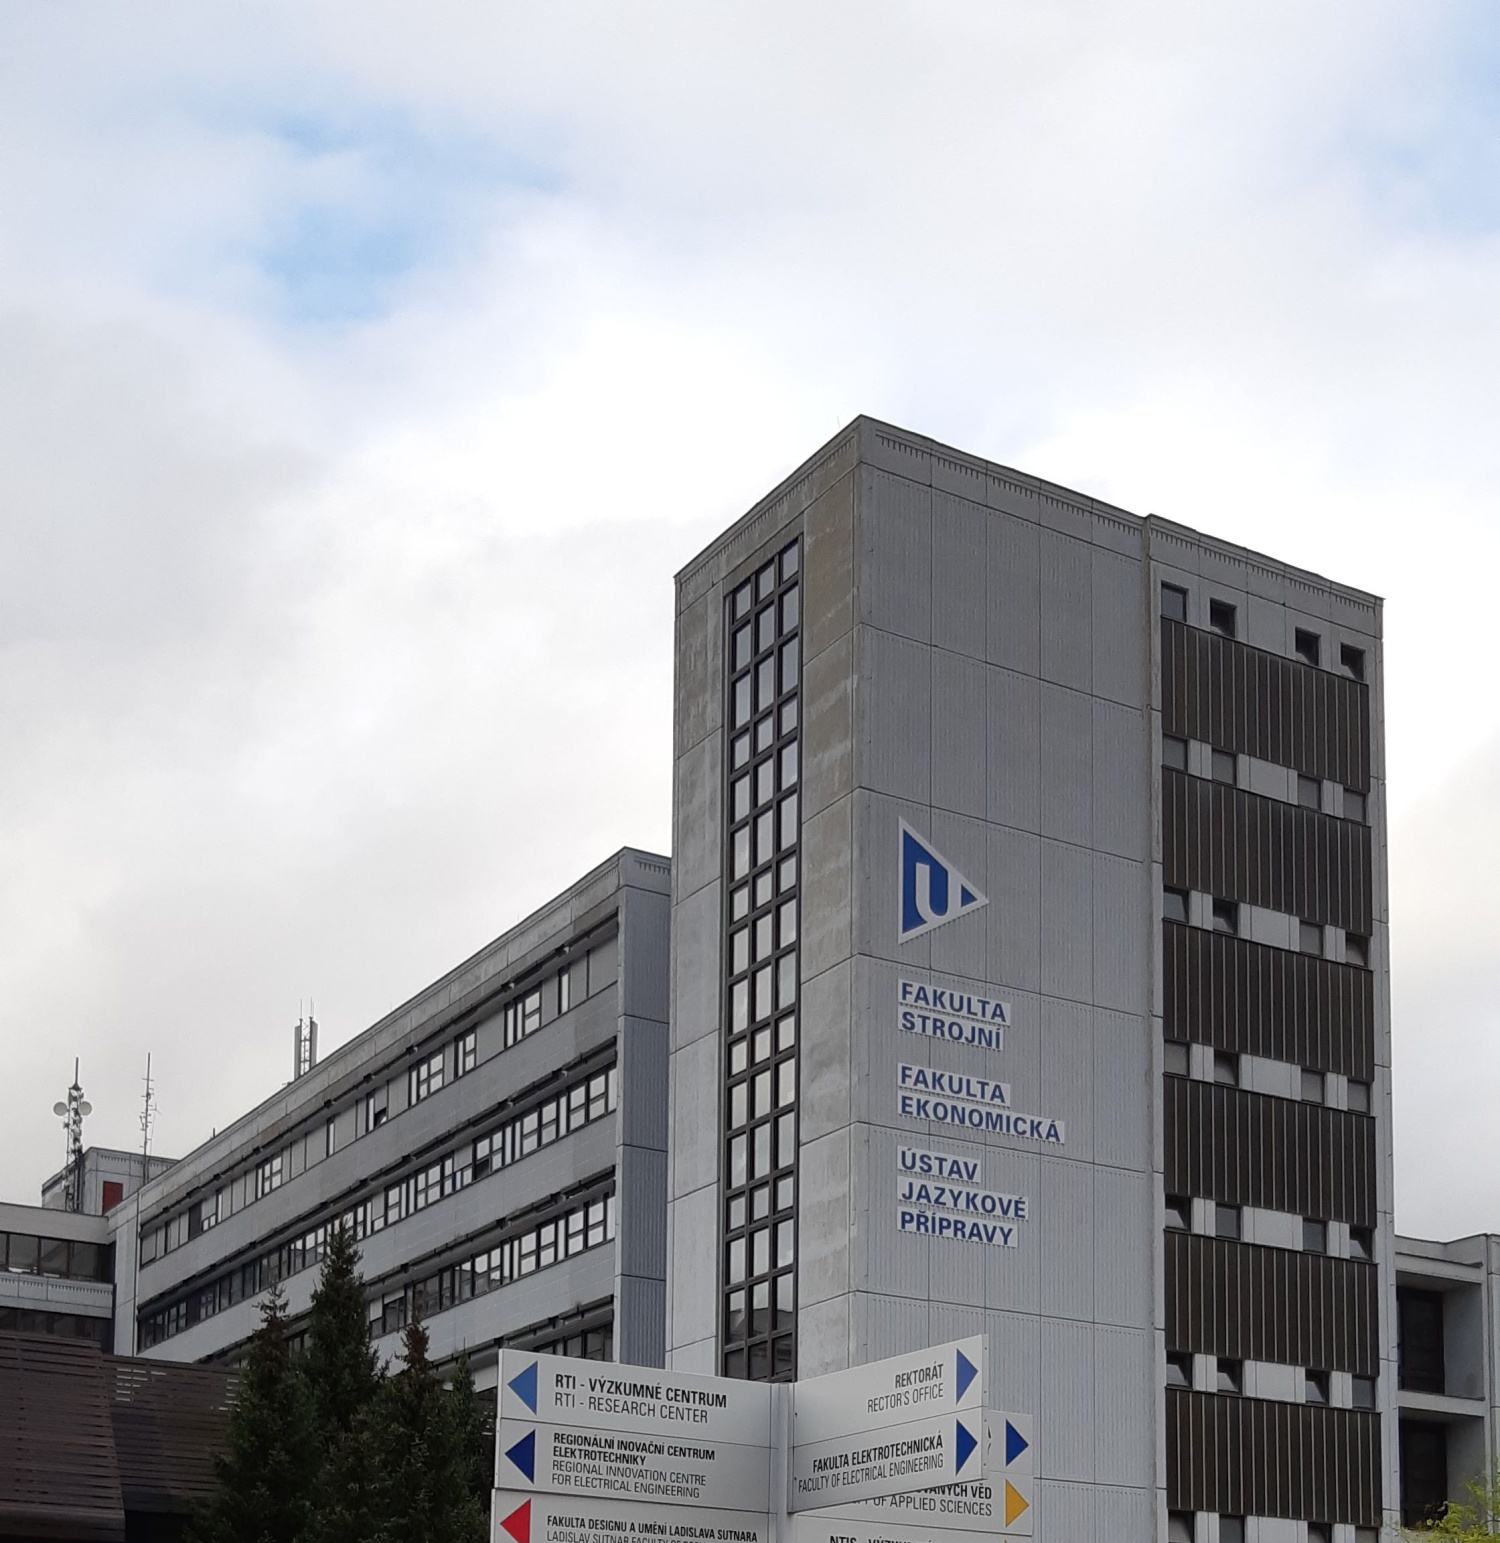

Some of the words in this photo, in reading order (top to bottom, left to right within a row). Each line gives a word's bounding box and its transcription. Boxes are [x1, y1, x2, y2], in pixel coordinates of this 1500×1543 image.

[902, 982, 1007, 1023] FAKULTA
[901, 1011, 1001, 1049] STROJNÍ
[901, 1065, 1006, 1104] FAKULTA
[901, 1095, 1061, 1143] EKONOMICKÁ
[901, 1148, 978, 1181] ÚSTAV
[901, 1181, 1026, 1219] JAZYKOVÉ
[901, 1210, 1013, 1246] PŘÍPRAVY
[555, 1373, 576, 1390] RTI
[589, 1375, 662, 1400] VÝZKUMNÉ
[666, 1387, 727, 1408] CENTRUM
[895, 1361, 944, 1389] REKTORÁT
[554, 1392, 575, 1408] RTI
[588, 1396, 656, 1417] RESEARCH
[660, 1404, 708, 1424] CENTER
[867, 1390, 910, 1414] RECTOR'S
[912, 1382, 944, 1404] OFFICE
[553, 1432, 615, 1450] REGIONÁLNÍ
[617, 1439, 665, 1455] INOVAČNÍ
[667, 1445, 716, 1461] CENTRUM
[553, 1446, 646, 1466] ELEKTROTECHNIKY
[813, 1453, 849, 1473] FAKULTA
[852, 1430, 943, 1466] ELEKTROTECHNICKÁ
[552, 1460, 603, 1476] REGIONAL
[606, 1465, 667, 1482] INNOVATION
[669, 1472, 706, 1486] CENTRE
[552, 1473, 571, 1486] FOR
[574, 1475, 632, 1492] ELECTRICAL
[634, 1482, 700, 1498] ENGINEERING
[798, 1475, 830, 1494] FACULTY
[831, 1473, 841, 1488] OF
[842, 1463, 887, 1486] ELECTRICAL
[889, 1452, 944, 1477] ENGINEERING
[890, 1495, 937, 1511] APPLIED
[939, 1499, 992, 1516] SCIENCES
[970, 1482, 992, 1500] VĚD
[547, 1515, 586, 1529] FAKULTA
[588, 1518, 627, 1532] DESIGNU
[629, 1522, 636, 1533] A
[638, 1521, 667, 1536] UMĚNÍ
[669, 1525, 715, 1539] LADISLAVA
[717, 1529, 758, 1543] SUTNARA
[547, 1530, 590, 1543] LADISLAV
